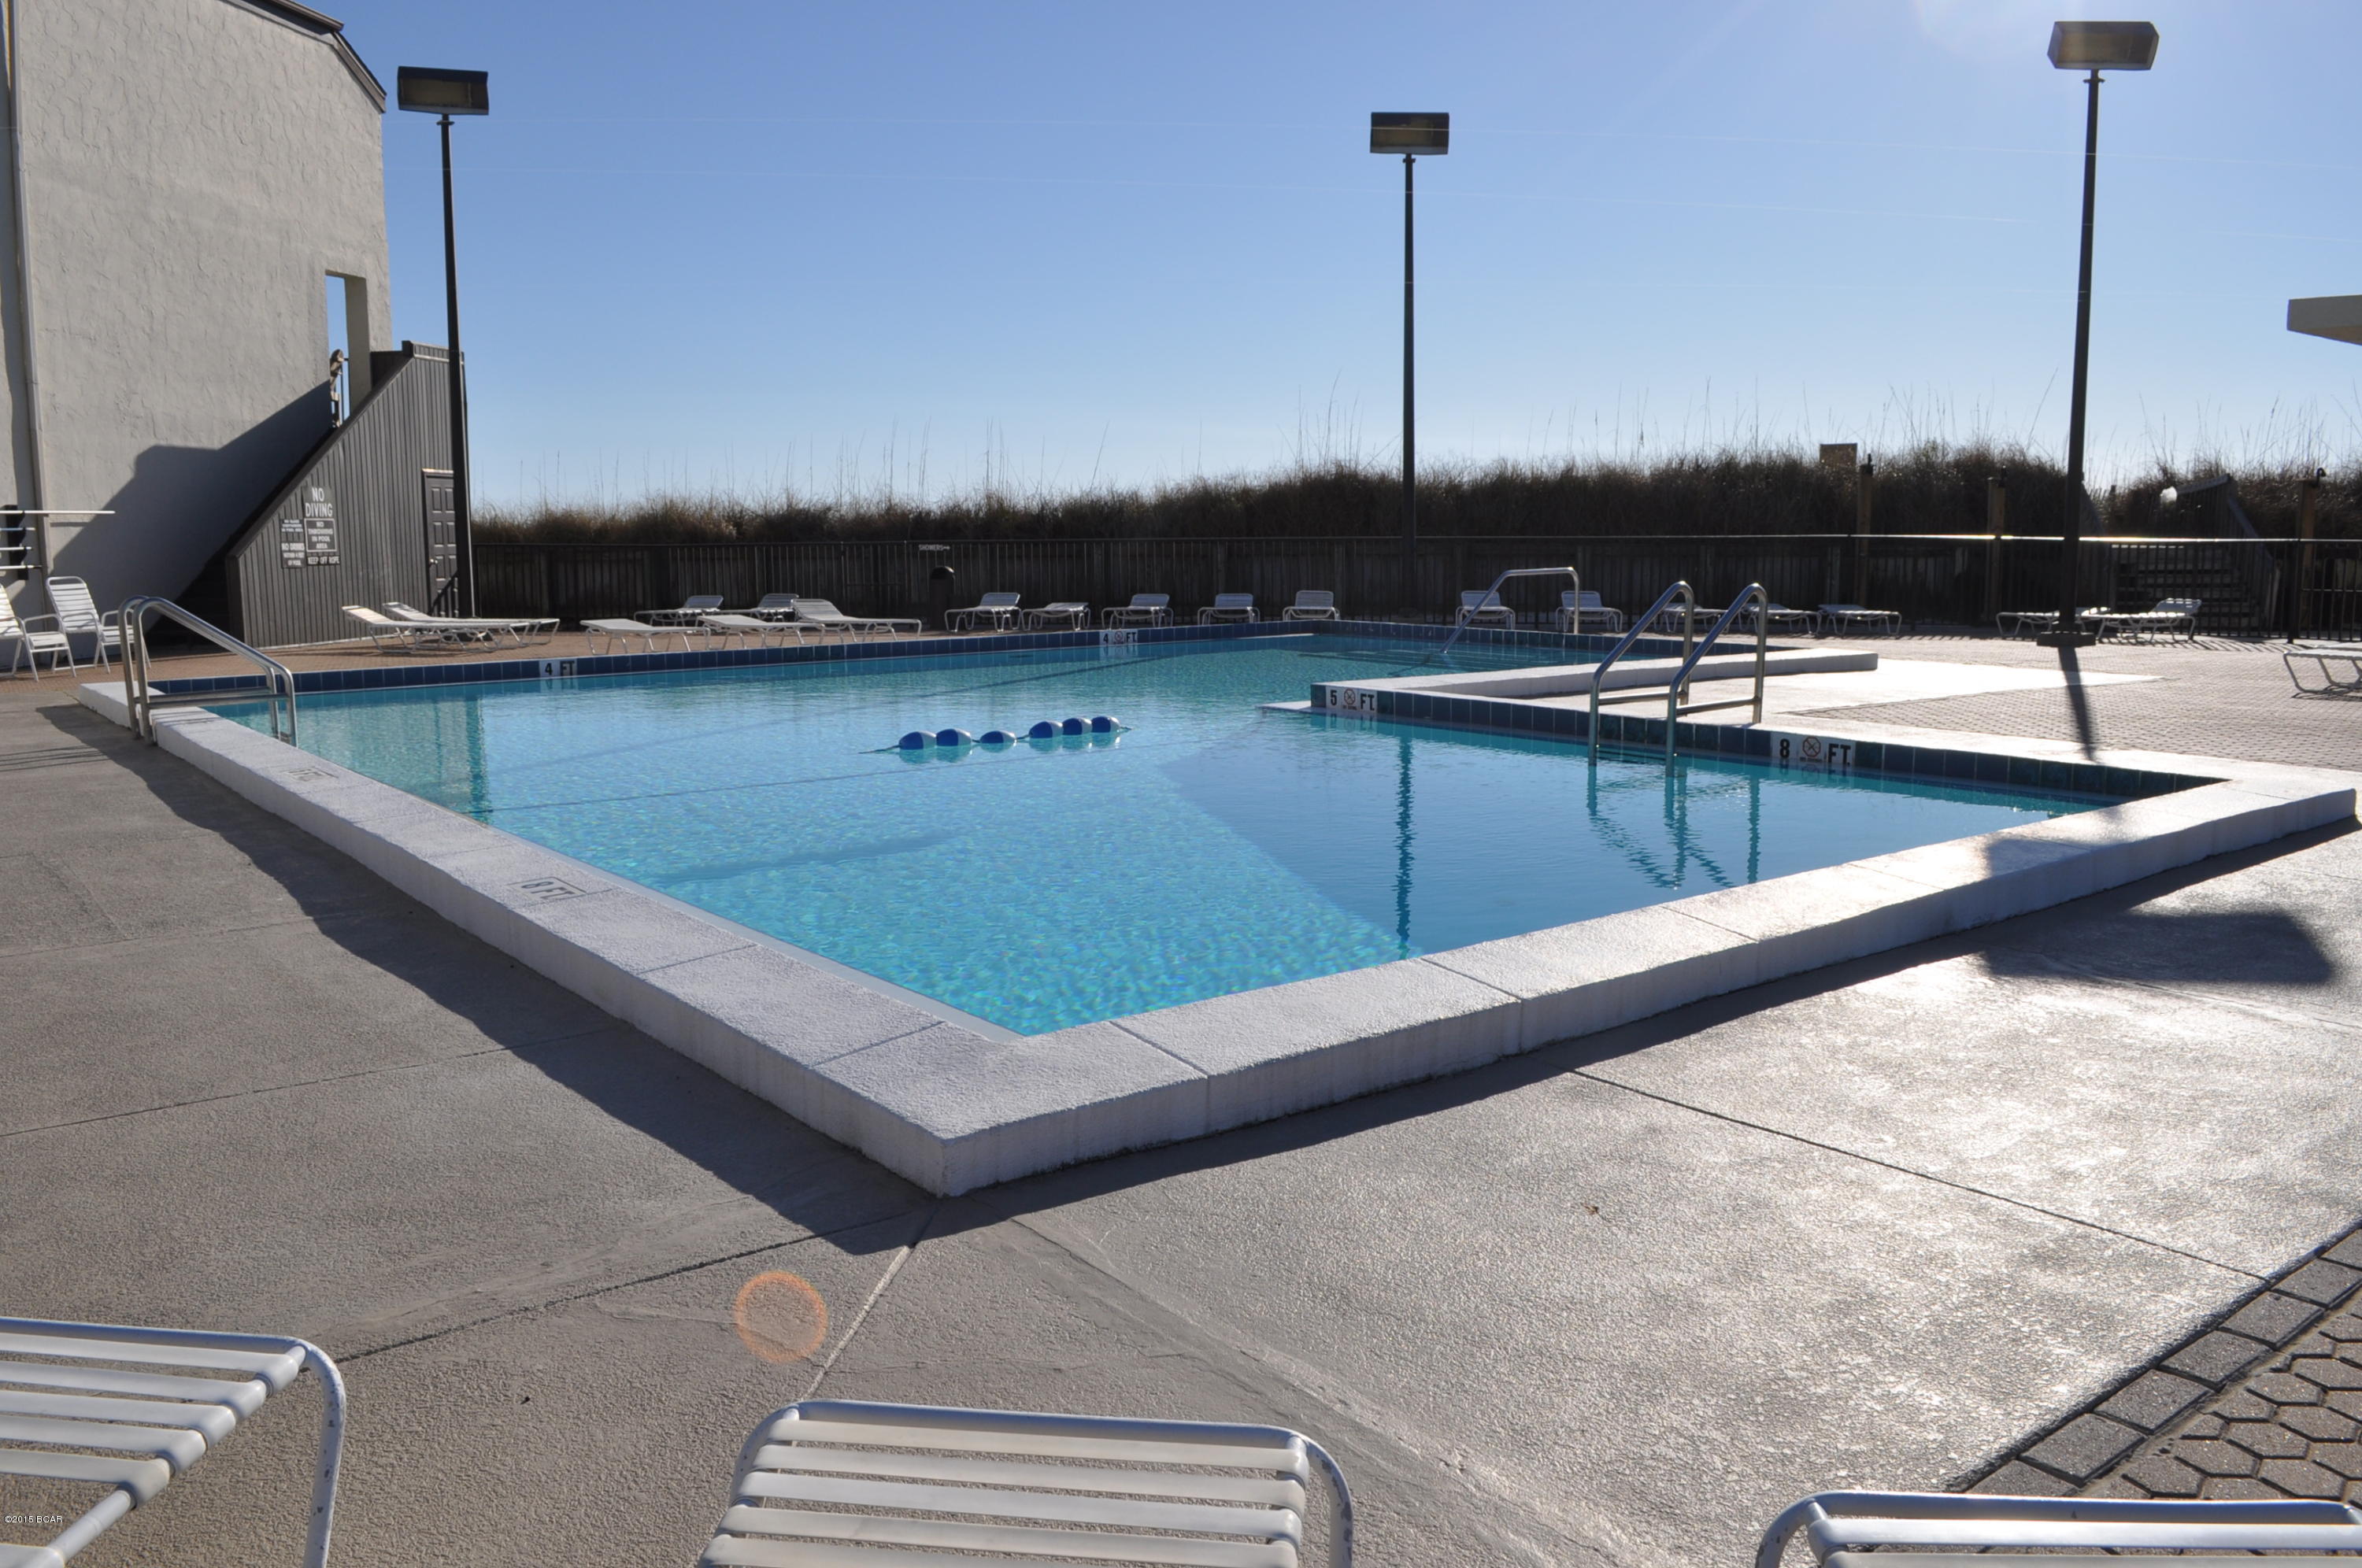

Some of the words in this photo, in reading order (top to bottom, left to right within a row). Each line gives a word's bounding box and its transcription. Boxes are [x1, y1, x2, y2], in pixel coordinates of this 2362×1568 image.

[312, 487, 324, 501] NO
[305, 502, 333, 517] DIVING
[1103, 633, 1109, 644] 4
[545, 662, 553, 676] 4
[1331, 690, 1337, 706] 5
[1780, 738, 1790, 759] 8
